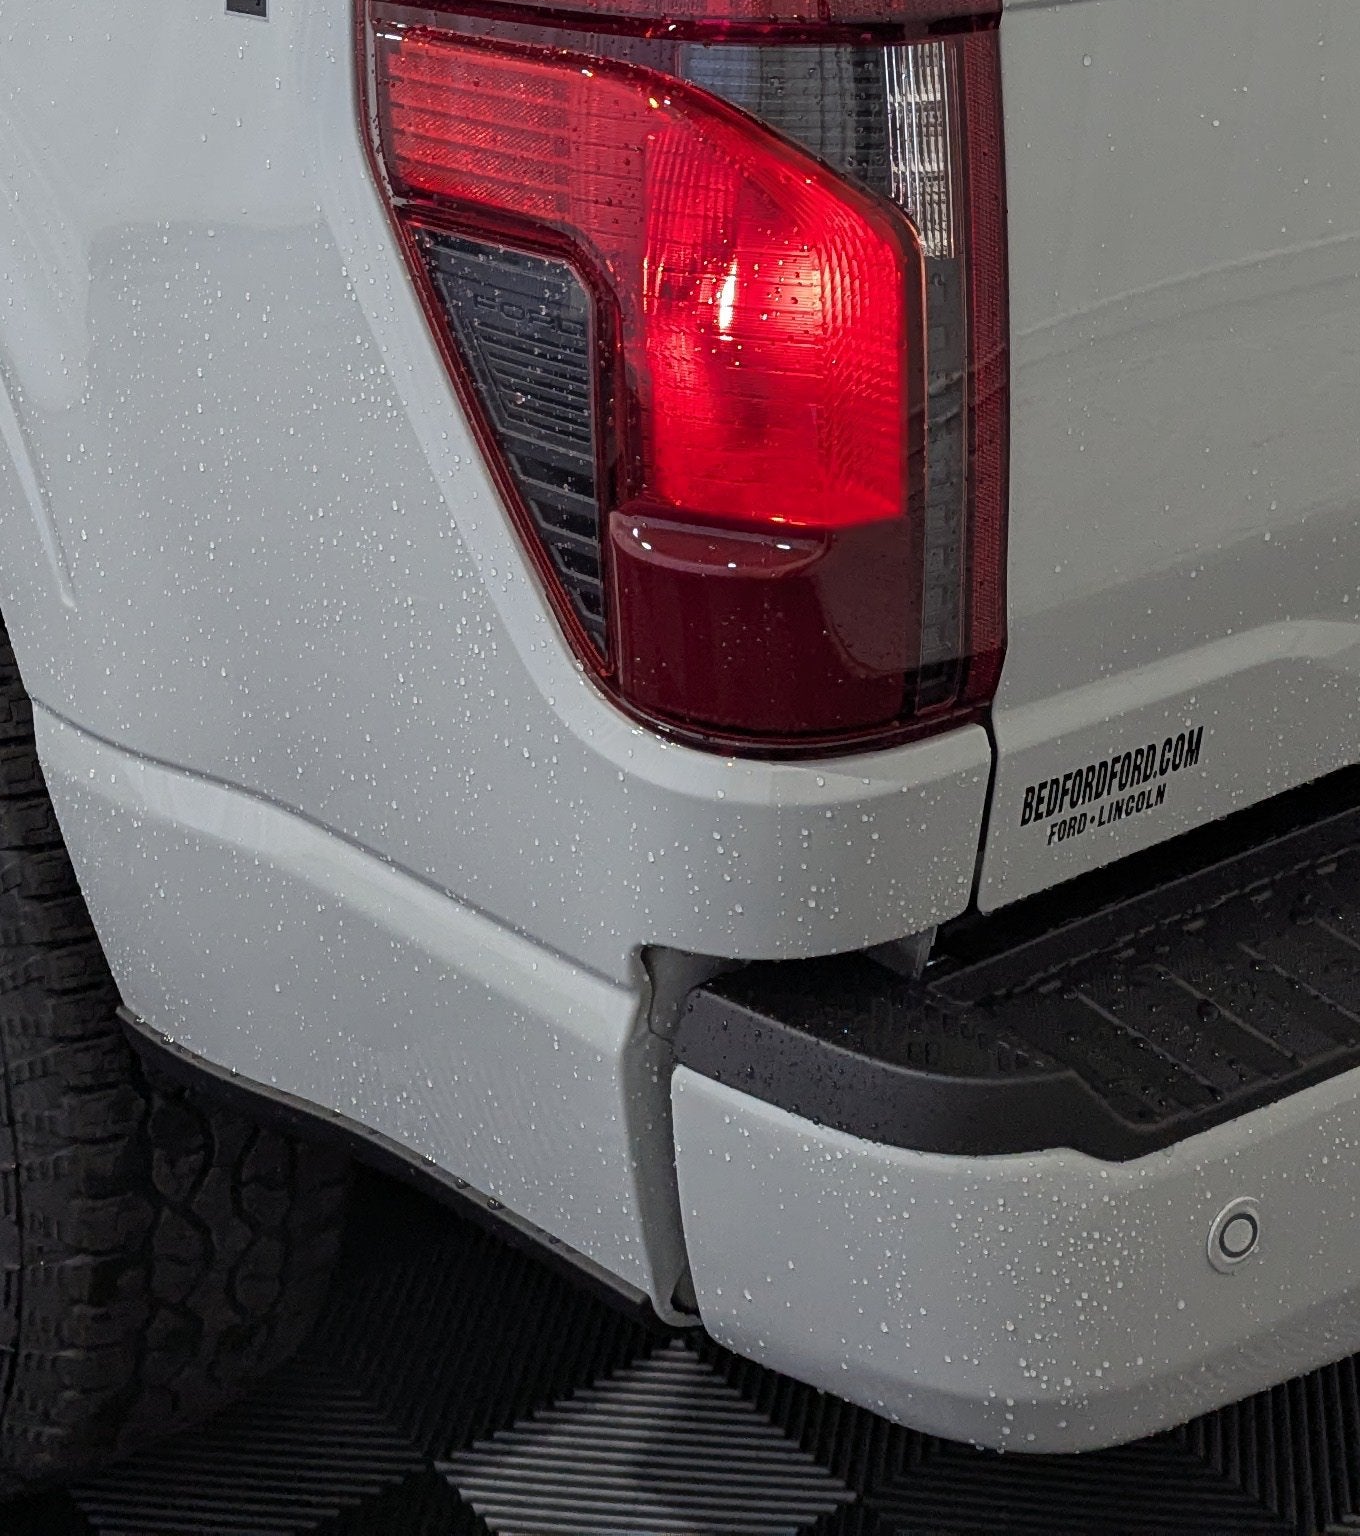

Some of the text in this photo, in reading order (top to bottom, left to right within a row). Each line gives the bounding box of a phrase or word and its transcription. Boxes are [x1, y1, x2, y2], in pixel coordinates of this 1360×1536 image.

[1020, 725, 1204, 827] BEDFORDFORD.COM
[1047, 783, 1167, 846] FORD LINCOLN
